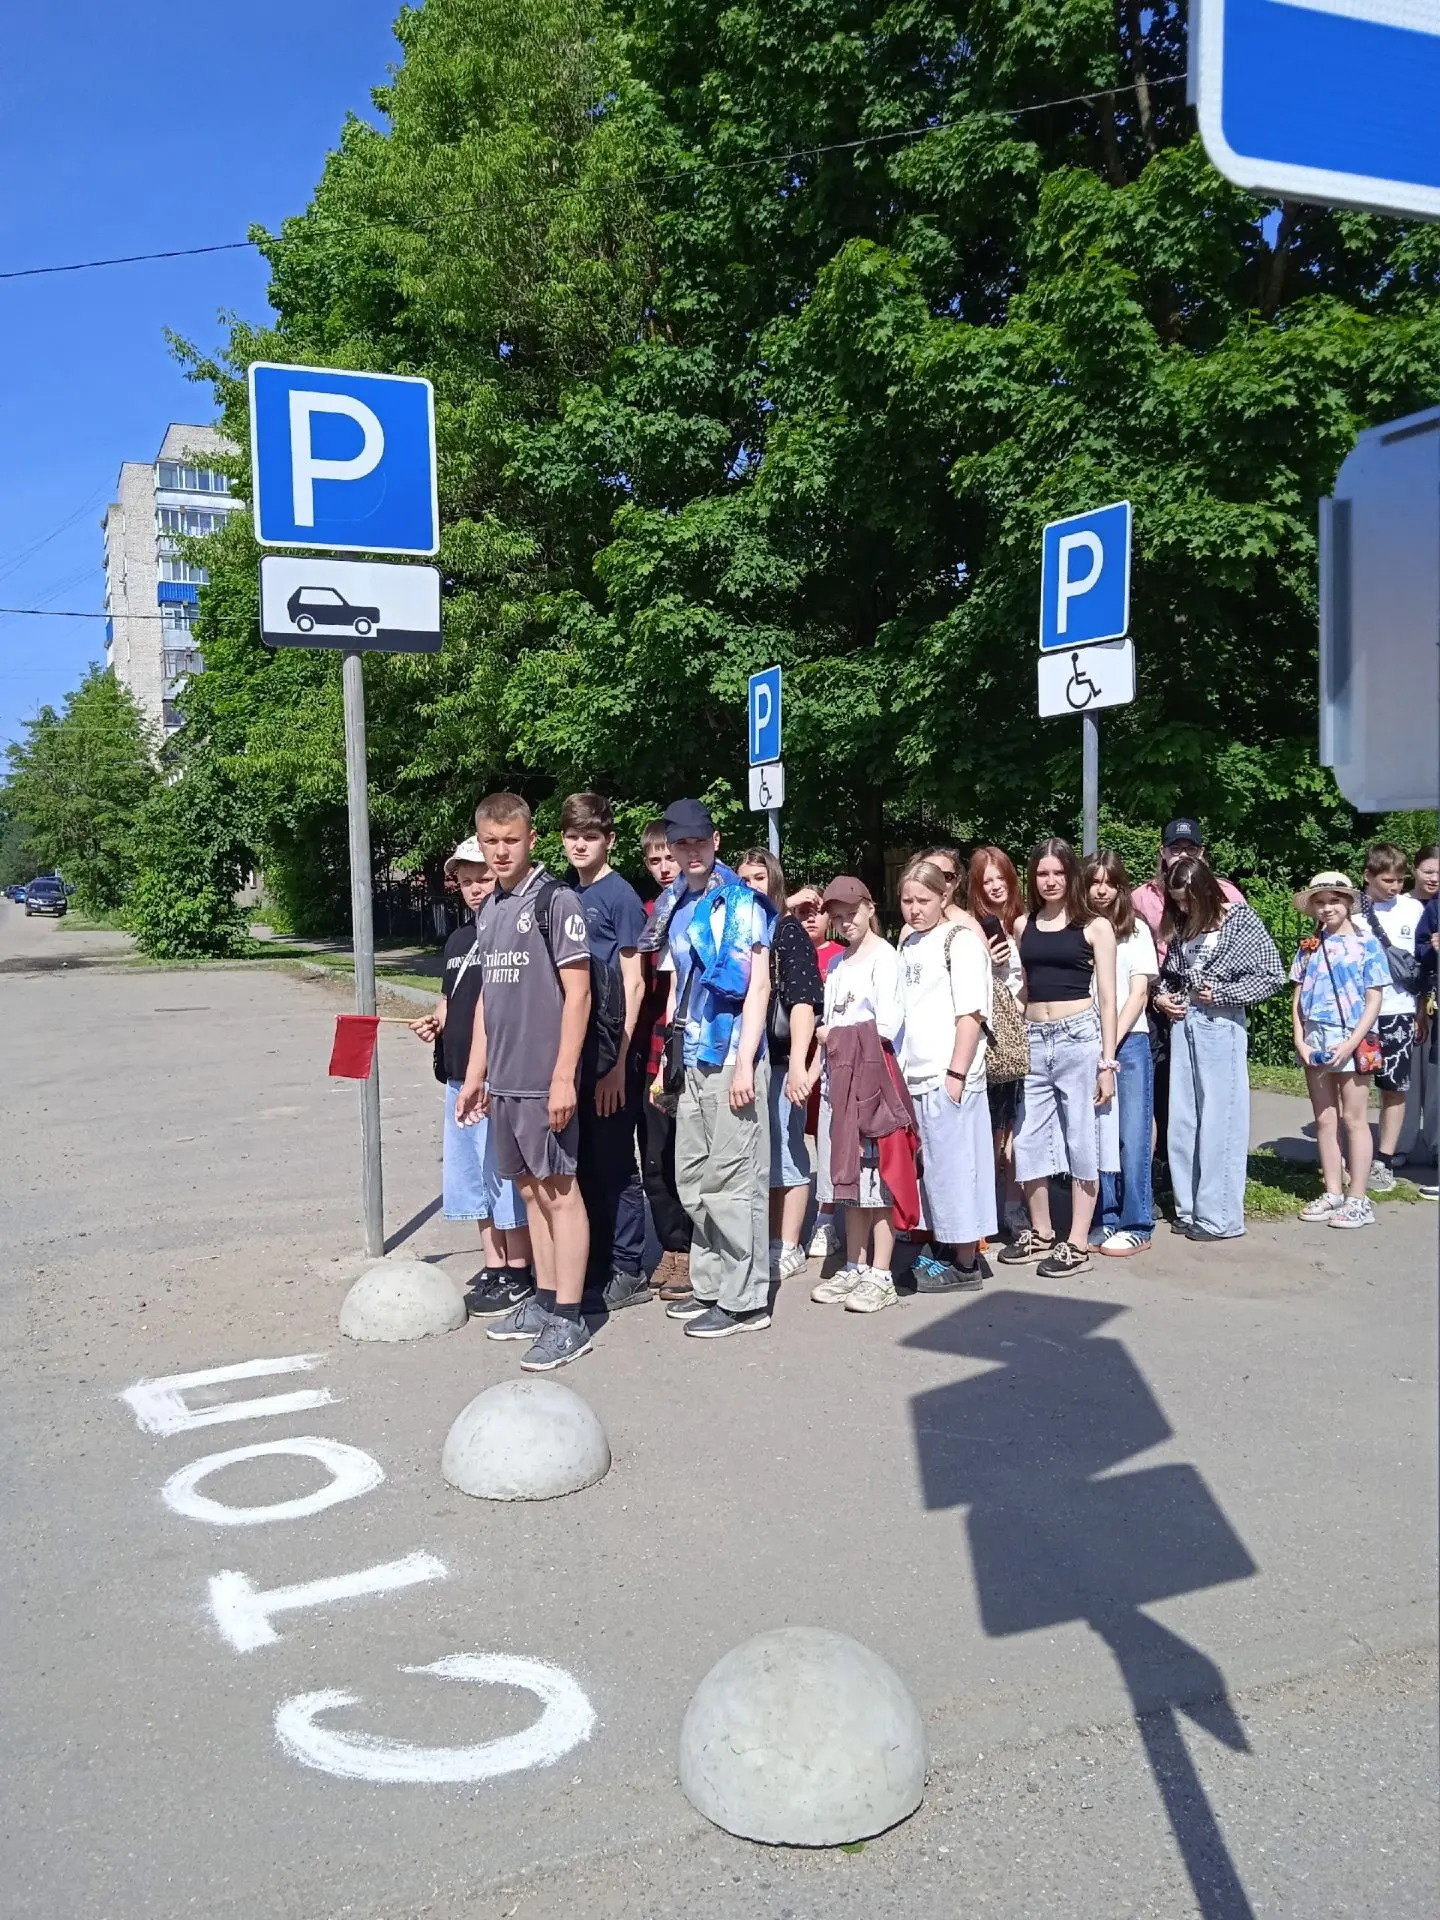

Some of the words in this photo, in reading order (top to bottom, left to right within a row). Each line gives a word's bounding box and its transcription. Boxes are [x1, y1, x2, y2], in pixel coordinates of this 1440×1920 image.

[288, 389, 385, 527] P
[1056, 530, 1104, 634] P
[754, 682, 772, 755] P
[569, 914, 584, 942] hp
[121, 1352, 598, 1784] СТОП
